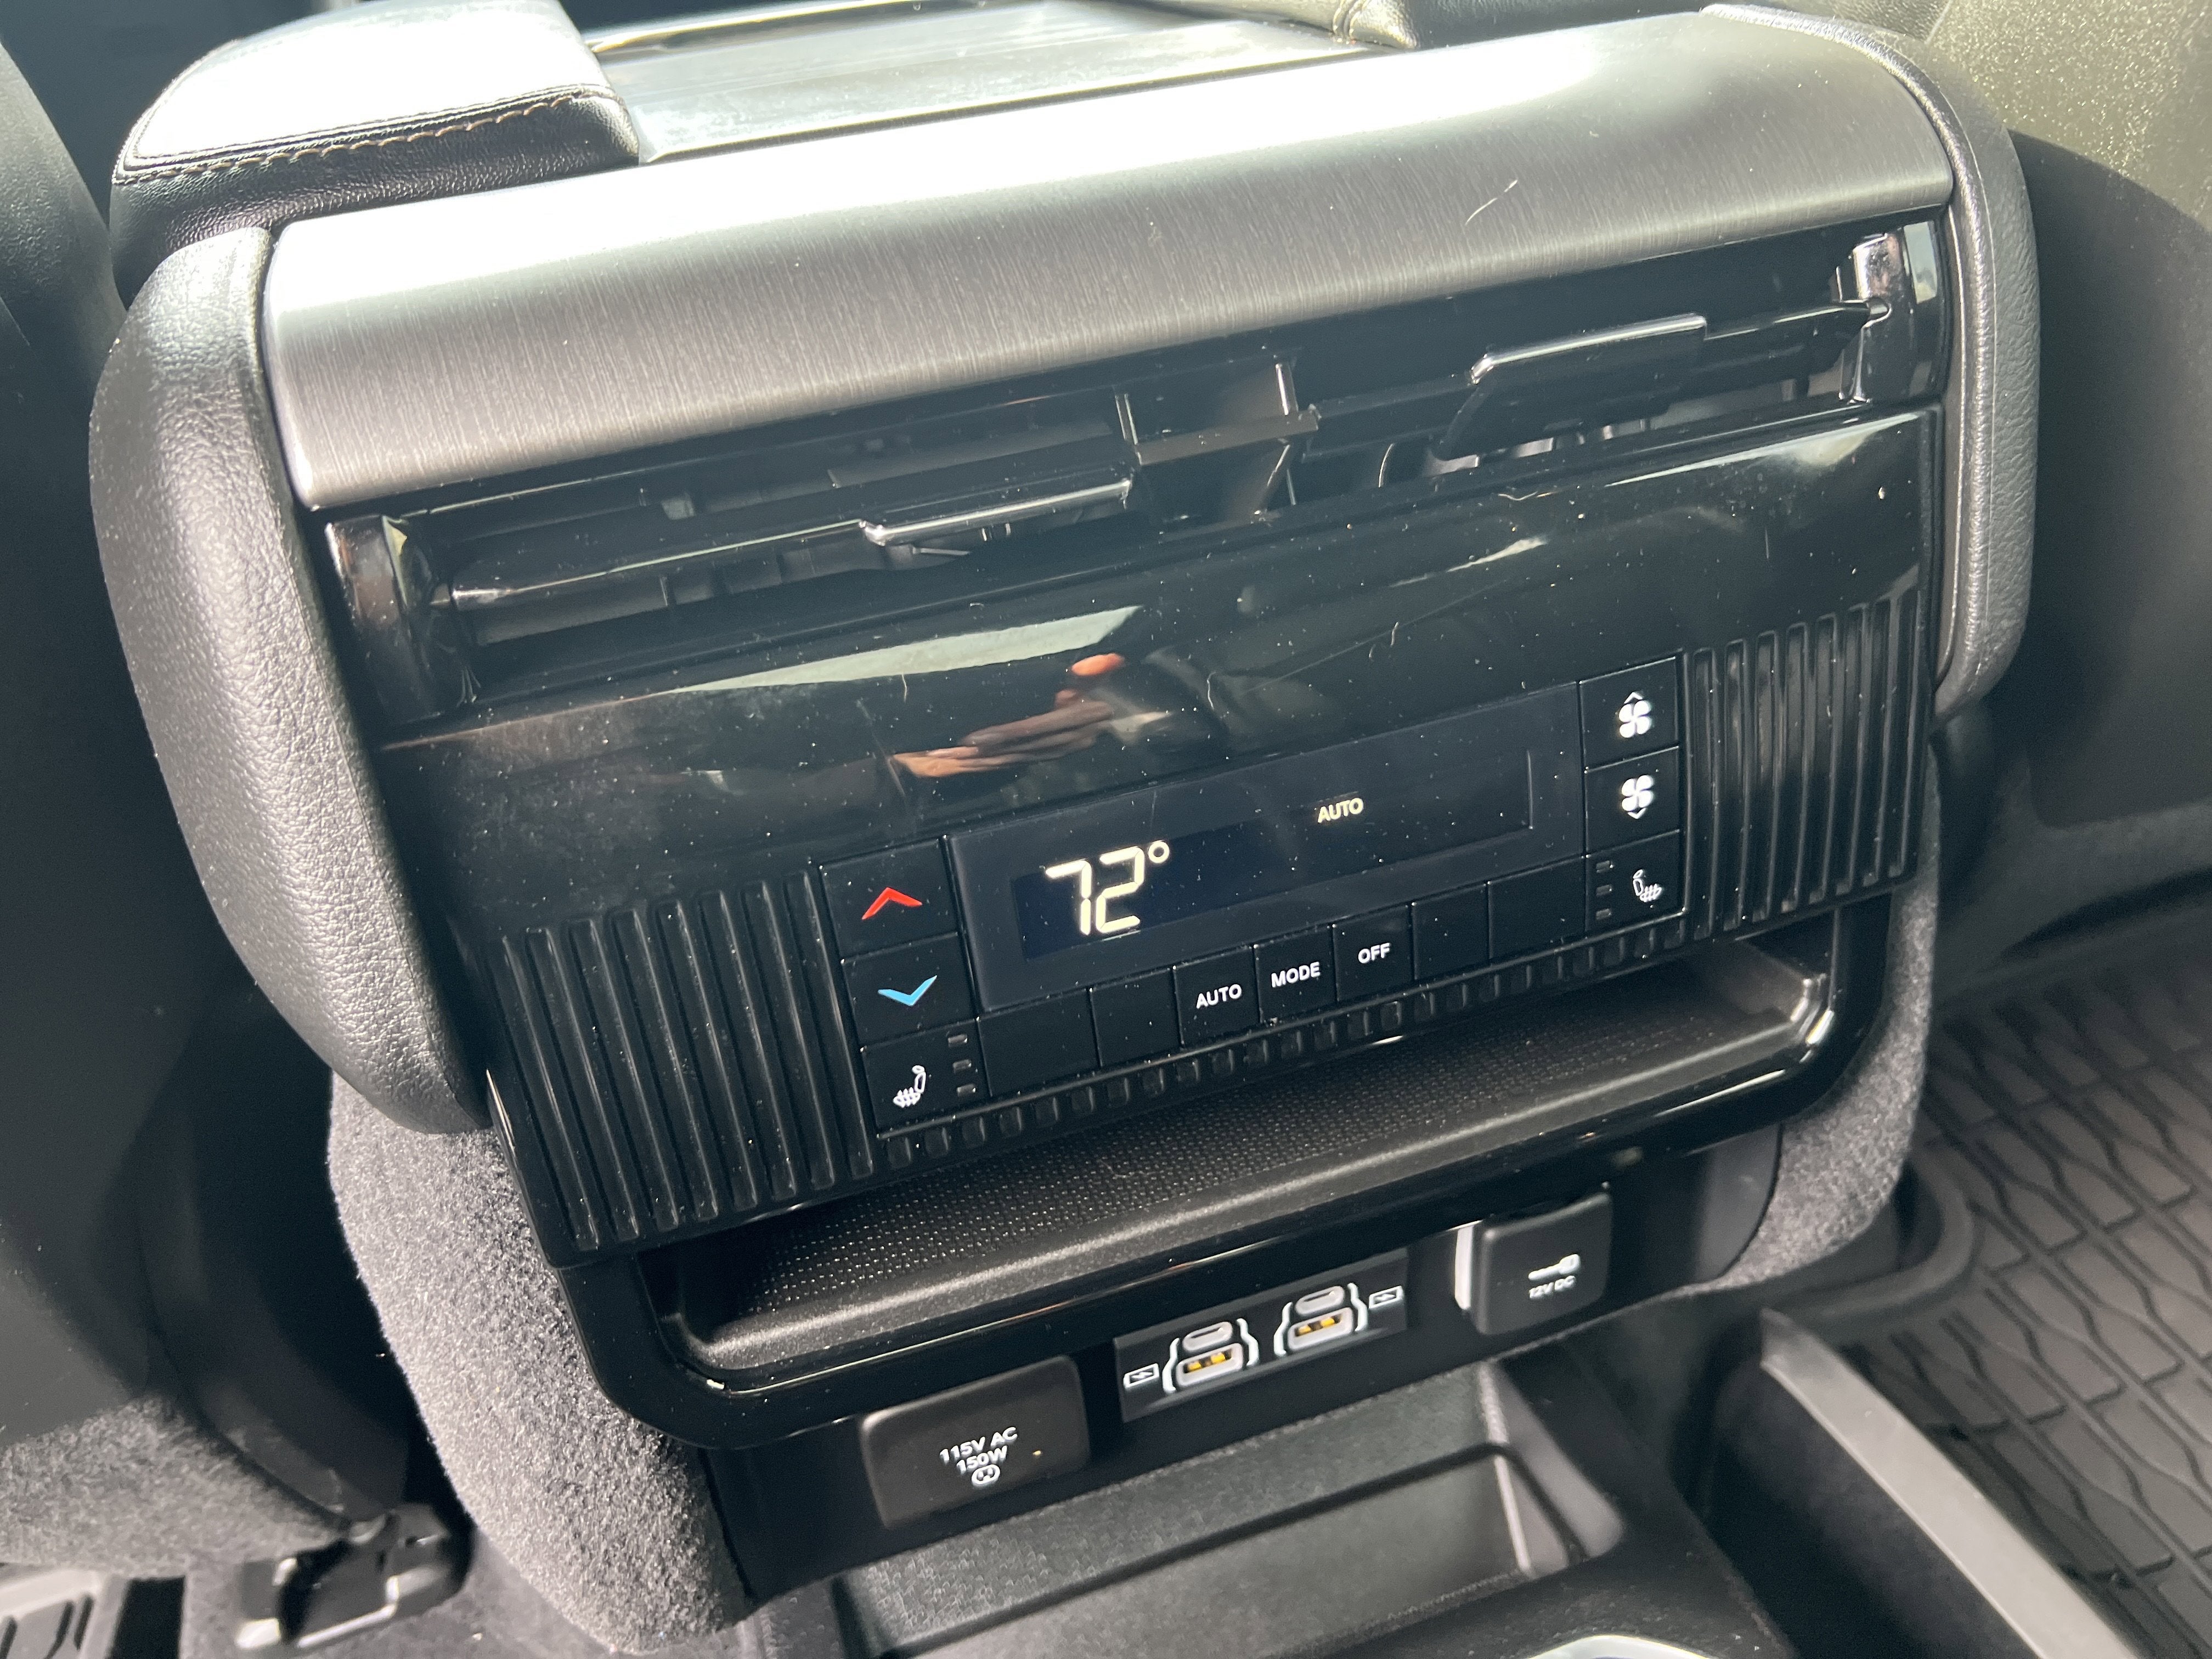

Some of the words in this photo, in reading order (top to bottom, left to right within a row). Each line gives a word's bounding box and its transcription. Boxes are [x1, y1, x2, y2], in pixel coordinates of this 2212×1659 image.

[1317, 797, 1364, 823] AUTO
[1357, 942, 1391, 964] OFF
[1271, 961, 1321, 988] MODE
[1196, 984, 1243, 1009] AUTO
[939, 1436, 986, 1463] 115V
[990, 1426, 1018, 1448] AC
[956, 1445, 1007, 1473] 150W
